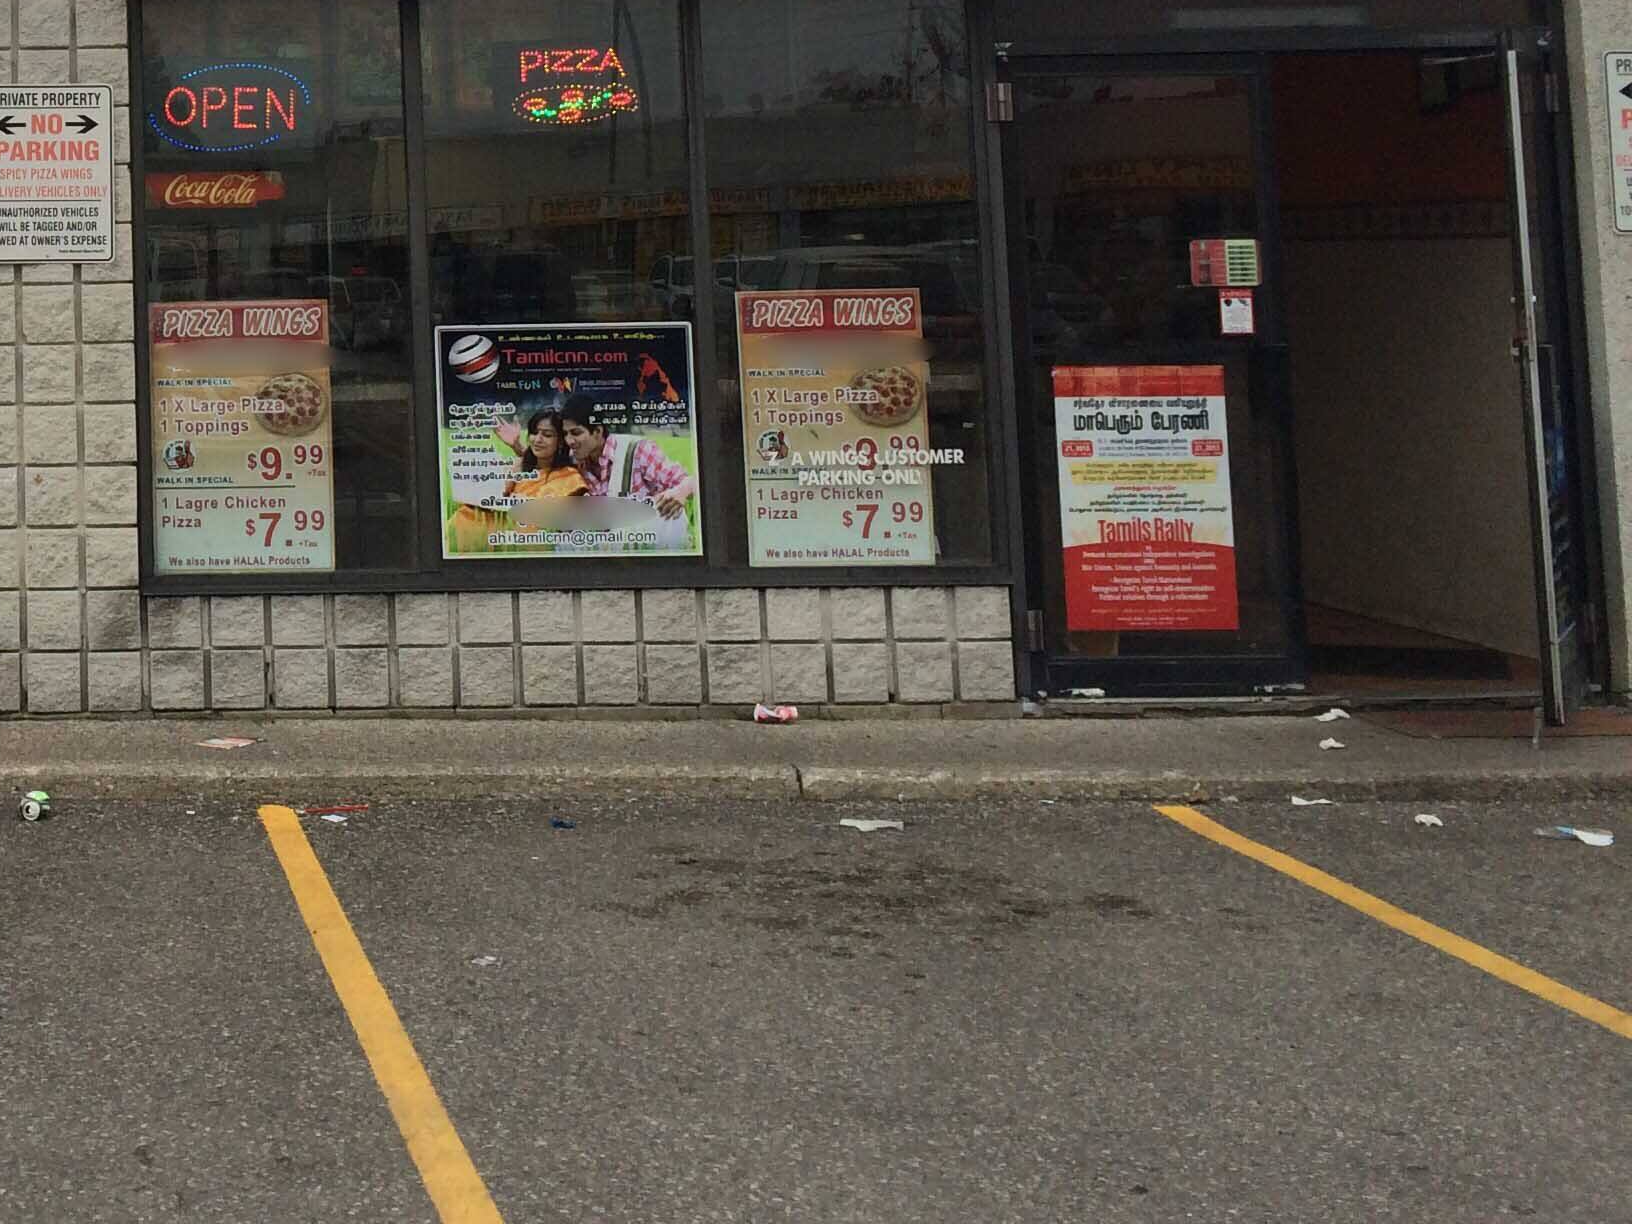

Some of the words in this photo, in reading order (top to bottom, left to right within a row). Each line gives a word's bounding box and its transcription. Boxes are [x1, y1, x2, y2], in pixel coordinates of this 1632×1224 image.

[520, 47, 626, 83] PIZZA
[42, 92, 101, 106] PROPERTY
[164, 86, 297, 131] OPEN
[31, 113, 63, 135] NO
[0, 168, 27, 180] SPICY
[30, 168, 57, 180] PIZZA
[60, 167, 93, 180] WINGS
[35, 186, 80, 198] VEHICLES
[83, 185, 108, 197] ONLY
[60, 207, 99, 217] VEHICLES
[20, 222, 30, 232] BE
[32, 222, 63, 232] TAGGED
[65, 222, 97, 231] AND/OR
[19, 236, 29, 246] AT
[31, 235, 69, 246] OWNER'S
[71, 235, 107, 245] EXPENSE
[752, 298, 824, 327] PIZZA
[834, 296, 913, 326] WINGS
[162, 308, 234, 337] PIZZA
[242, 307, 322, 337] WINGS
[502, 349, 628, 365] Tamilcnn.com
[752, 391, 759, 403] 1
[767, 391, 777, 403] X
[784, 390, 828, 405] Large
[835, 388, 879, 402] Pizza
[160, 400, 167, 412] 1
[175, 400, 184, 412] X
[191, 399, 235, 415] Large
[241, 398, 284, 412] Pizza
[753, 411, 760, 423] 1
[768, 410, 844, 425] Toppings
[160, 420, 167, 432] 1
[175, 419, 249, 435] Toppings
[247, 445, 324, 480] $9.99
[809, 449, 869, 466] WINGS
[798, 470, 874, 486] PARKING
[758, 489, 764, 501] 1
[771, 488, 815, 503] Lagre
[821, 487, 884, 501] Chicken
[161, 498, 168, 510] 1
[175, 497, 218, 512] Lagre
[224, 496, 286, 510] Chicken
[758, 507, 798, 520] Pizza
[843, 502, 924, 539] $7.99
[161, 516, 202, 528] Pizza
[245, 510, 325, 547] $7.99
[1097, 516, 1152, 542] Tamils
[1154, 517, 1195, 542] Rally
[233, 556, 266, 565] HALAL
[268, 556, 310, 565] Products
[832, 549, 864, 557] HALAL
[867, 548, 909, 557] Products
